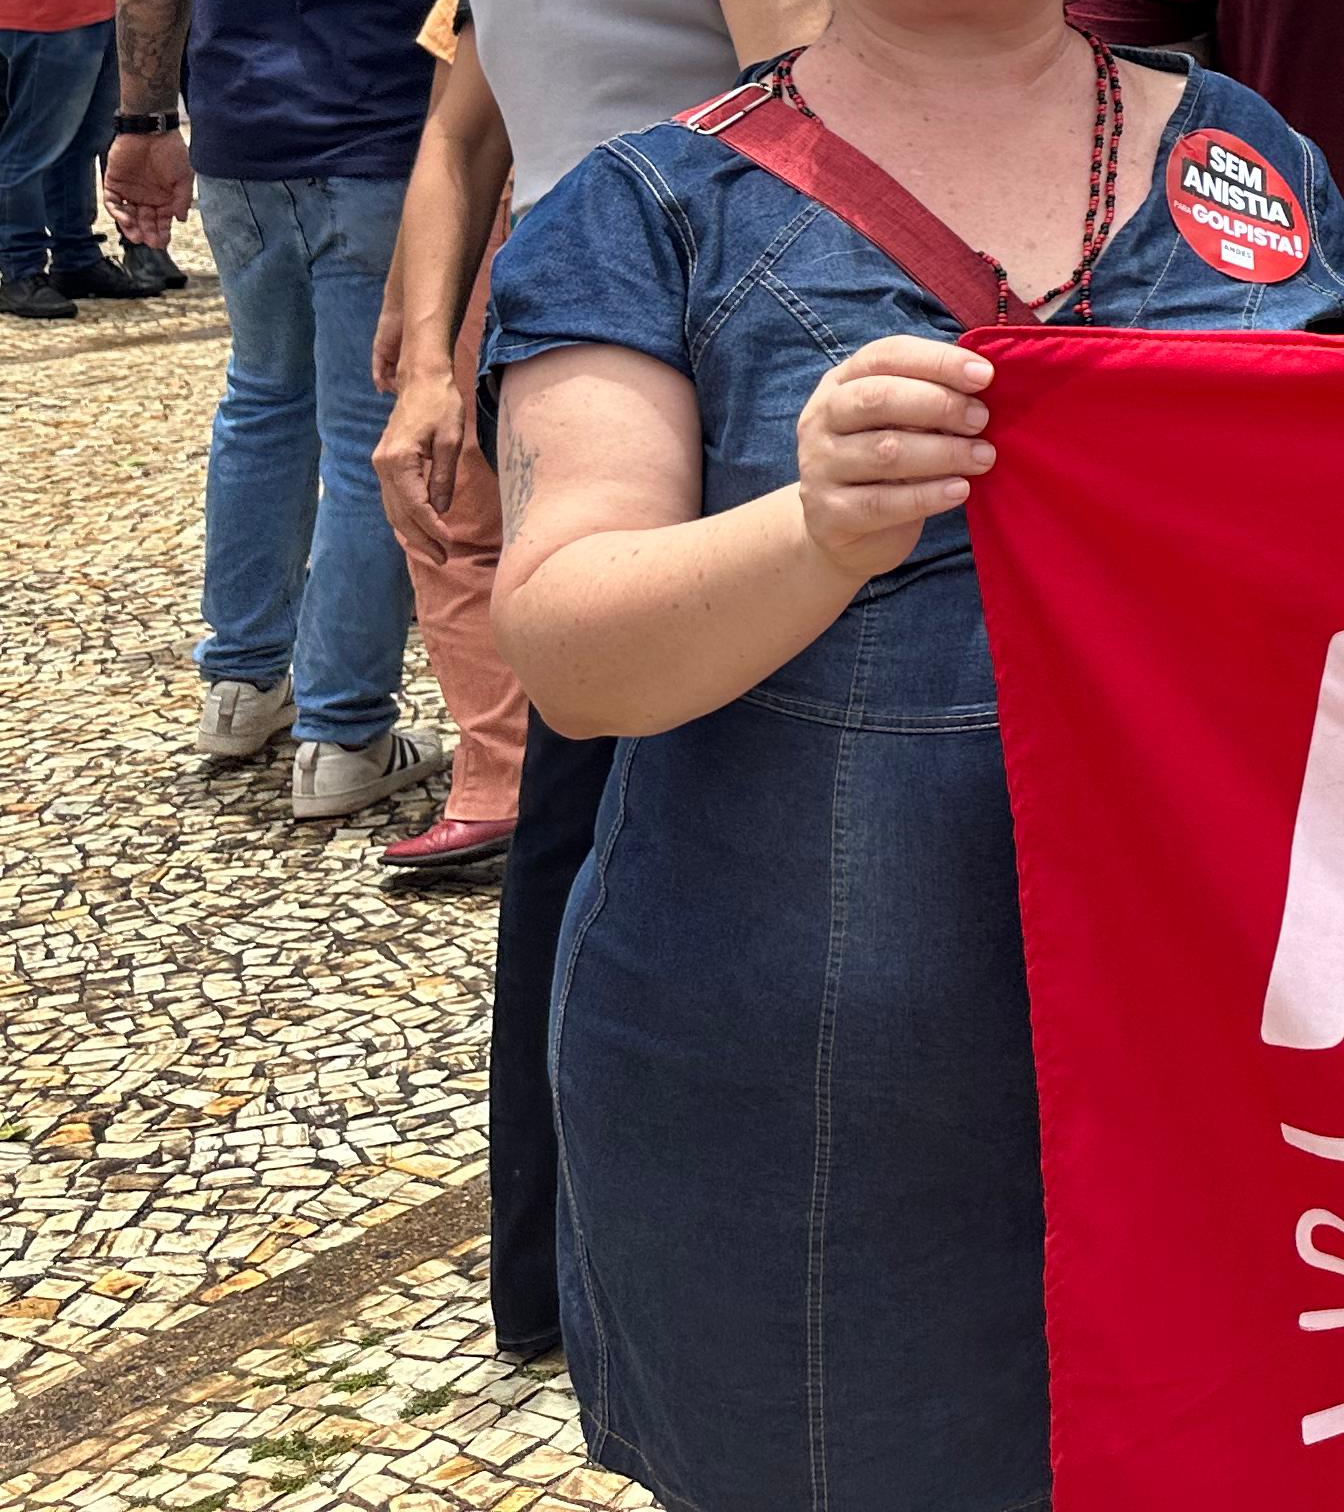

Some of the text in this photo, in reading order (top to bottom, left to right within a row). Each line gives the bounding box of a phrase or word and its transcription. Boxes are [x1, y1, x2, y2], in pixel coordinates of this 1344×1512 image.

[1183, 164, 1290, 228] ANISTIA
[1209, 145, 1263, 192] SEM
[1191, 203, 1304, 259] GOLPISTA!
